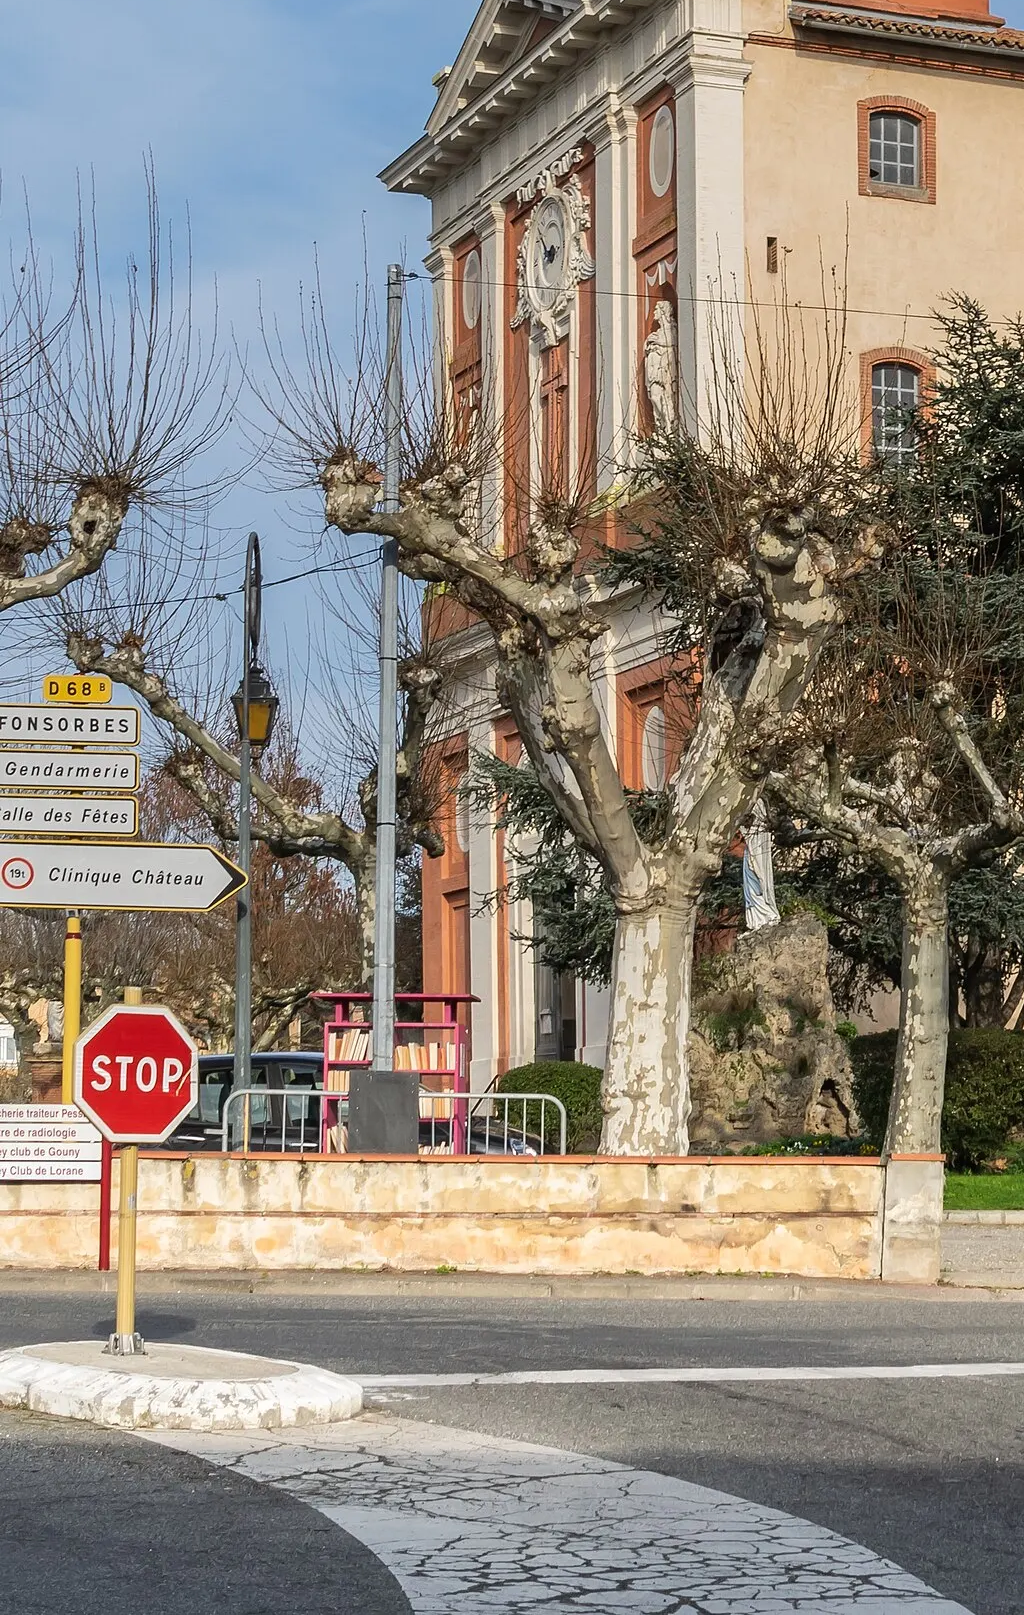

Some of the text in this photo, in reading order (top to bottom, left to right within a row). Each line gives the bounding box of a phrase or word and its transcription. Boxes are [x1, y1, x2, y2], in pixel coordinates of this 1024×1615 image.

[49, 681, 106, 696] D 68 B
[0, 716, 129, 733] FONSORBES
[5, 761, 129, 778] Gendarmerie
[0, 806, 128, 823] alle des Fêtes
[9, 867, 204, 886] 19t Clinique Château
[90, 1054, 184, 1093] STOP
[26, 1108, 59, 1118] traiteur
[13, 1127, 25, 1137] de
[28, 1127, 77, 1139] radiologie
[10, 1146, 31, 1156] club
[33, 1147, 45, 1156] de
[48, 1146, 80, 1158] Gouny
[10, 1165, 32, 1175] Club
[35, 1166, 47, 1175] de
[50, 1166, 84, 1175] Lorane
